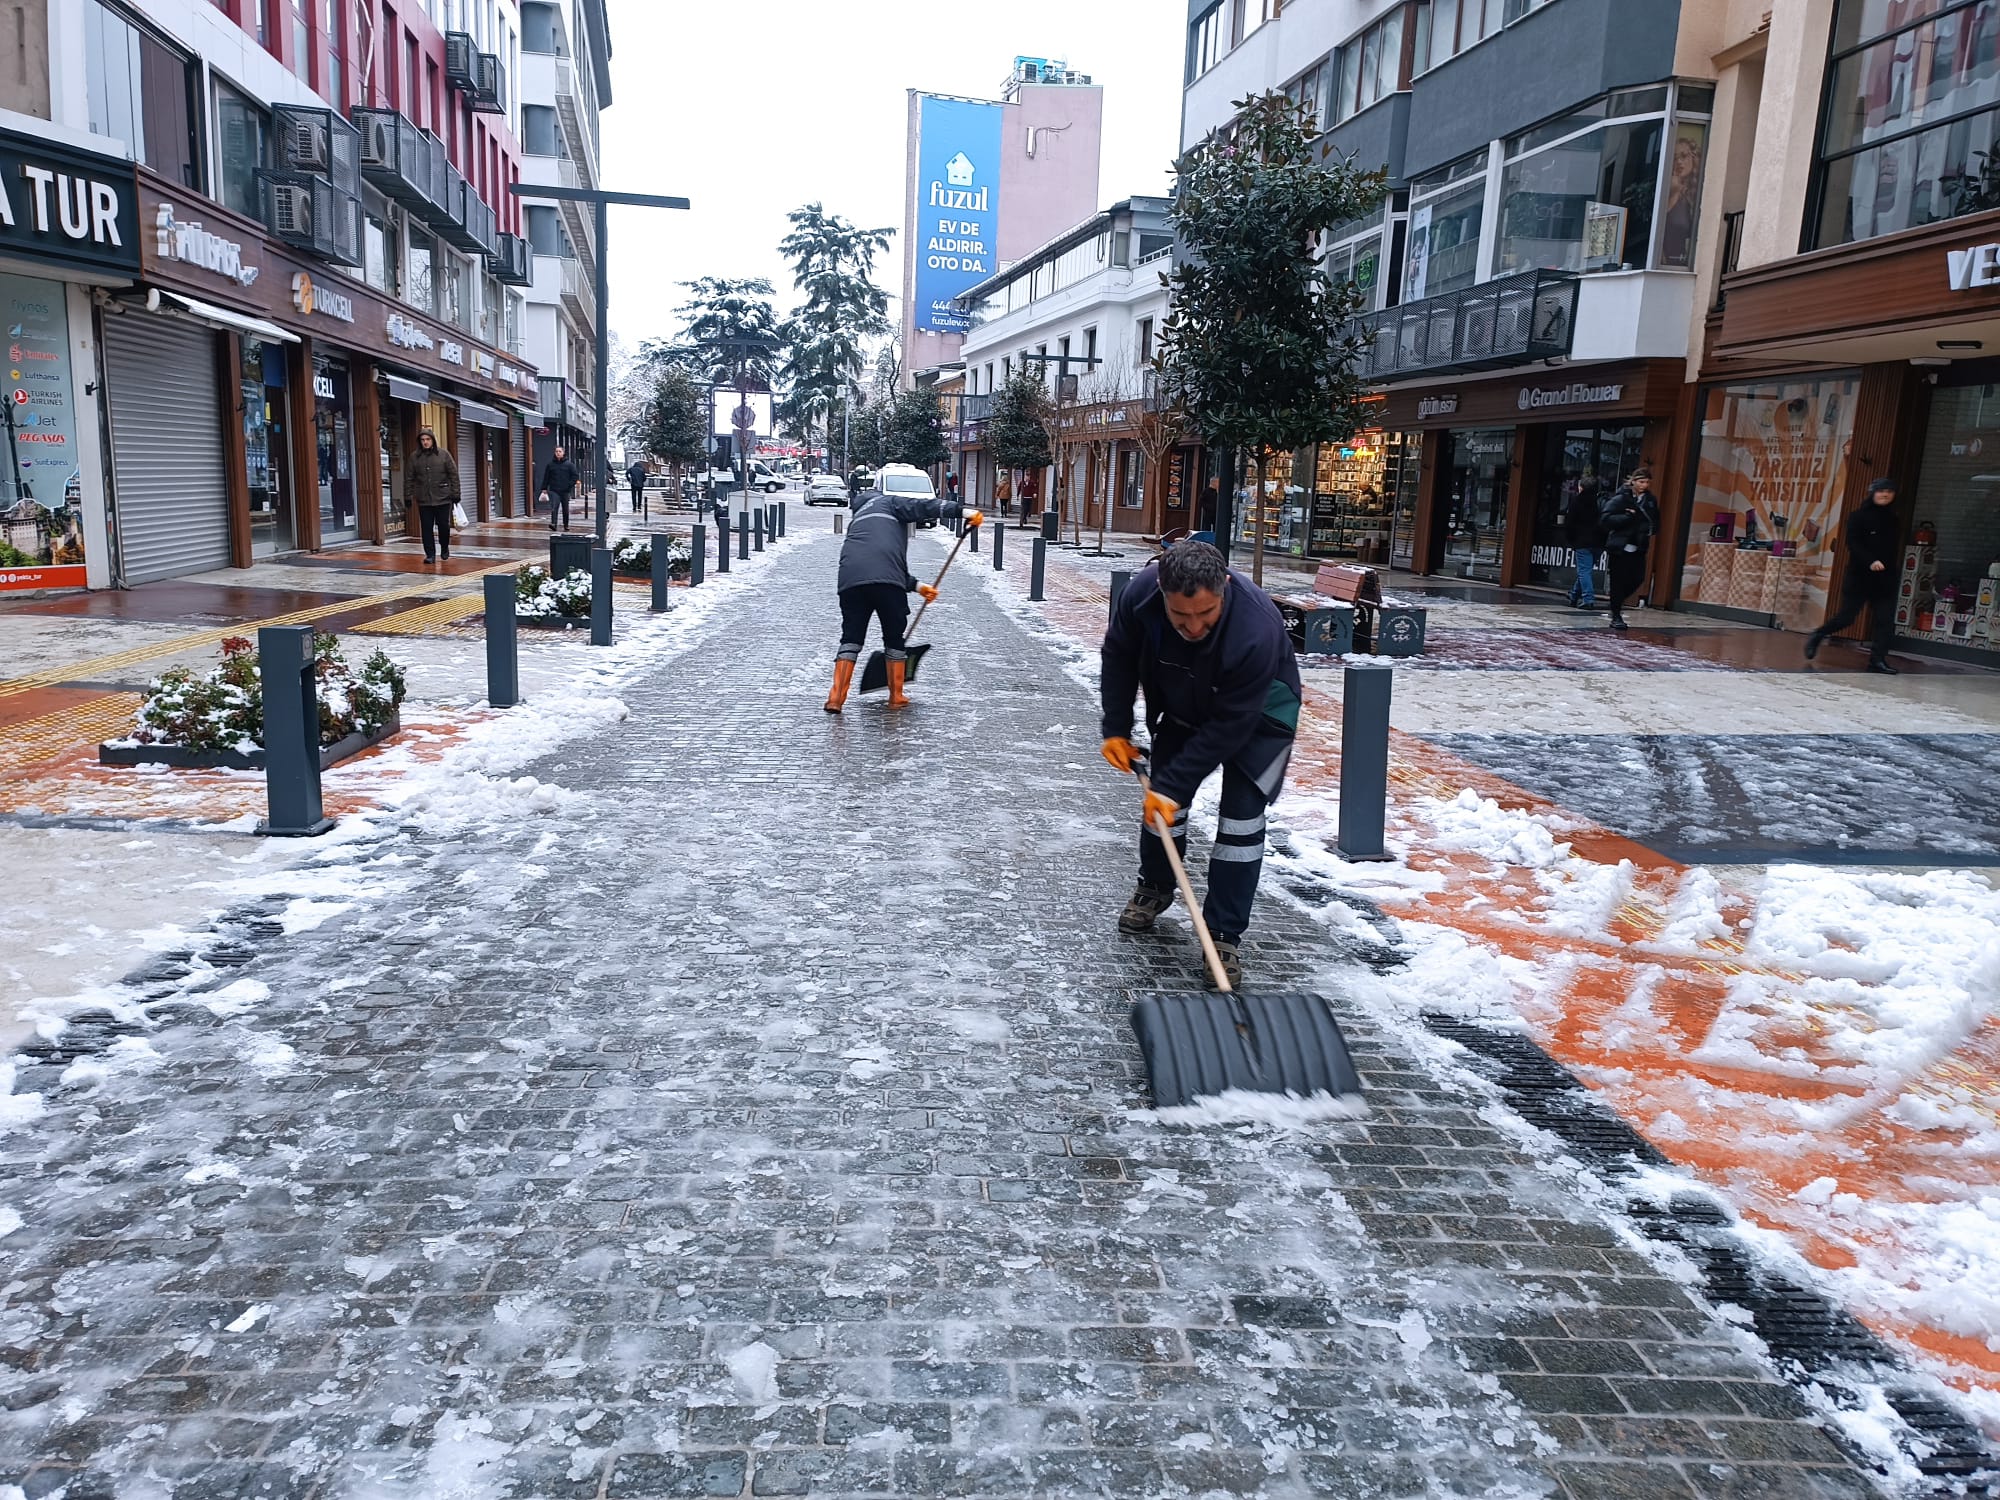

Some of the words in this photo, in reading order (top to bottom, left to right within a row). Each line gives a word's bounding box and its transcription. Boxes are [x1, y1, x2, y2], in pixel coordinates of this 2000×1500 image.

[25, 164, 122, 247] TUR
[929, 180, 989, 212] fuzul
[938, 219, 957, 234] EV
[960, 221, 980, 236] DE
[928, 237, 988, 255] ALDIRIR.
[927, 255, 959, 271] OTO
[962, 258, 987, 273] DA.
[1947, 243, 2000, 290] VE
[312, 284, 355, 323] TURKCELL
[24, 371, 60, 381] Lufthansa
[31, 390, 62, 399] TURKISH
[1530, 385, 1569, 407] Grand
[1571, 383, 1624, 404] Flower
[18, 432, 65, 444] PEGASUS
[1750, 481, 1825, 503] YANSITIN
[1531, 545, 1564, 567] GRAND
